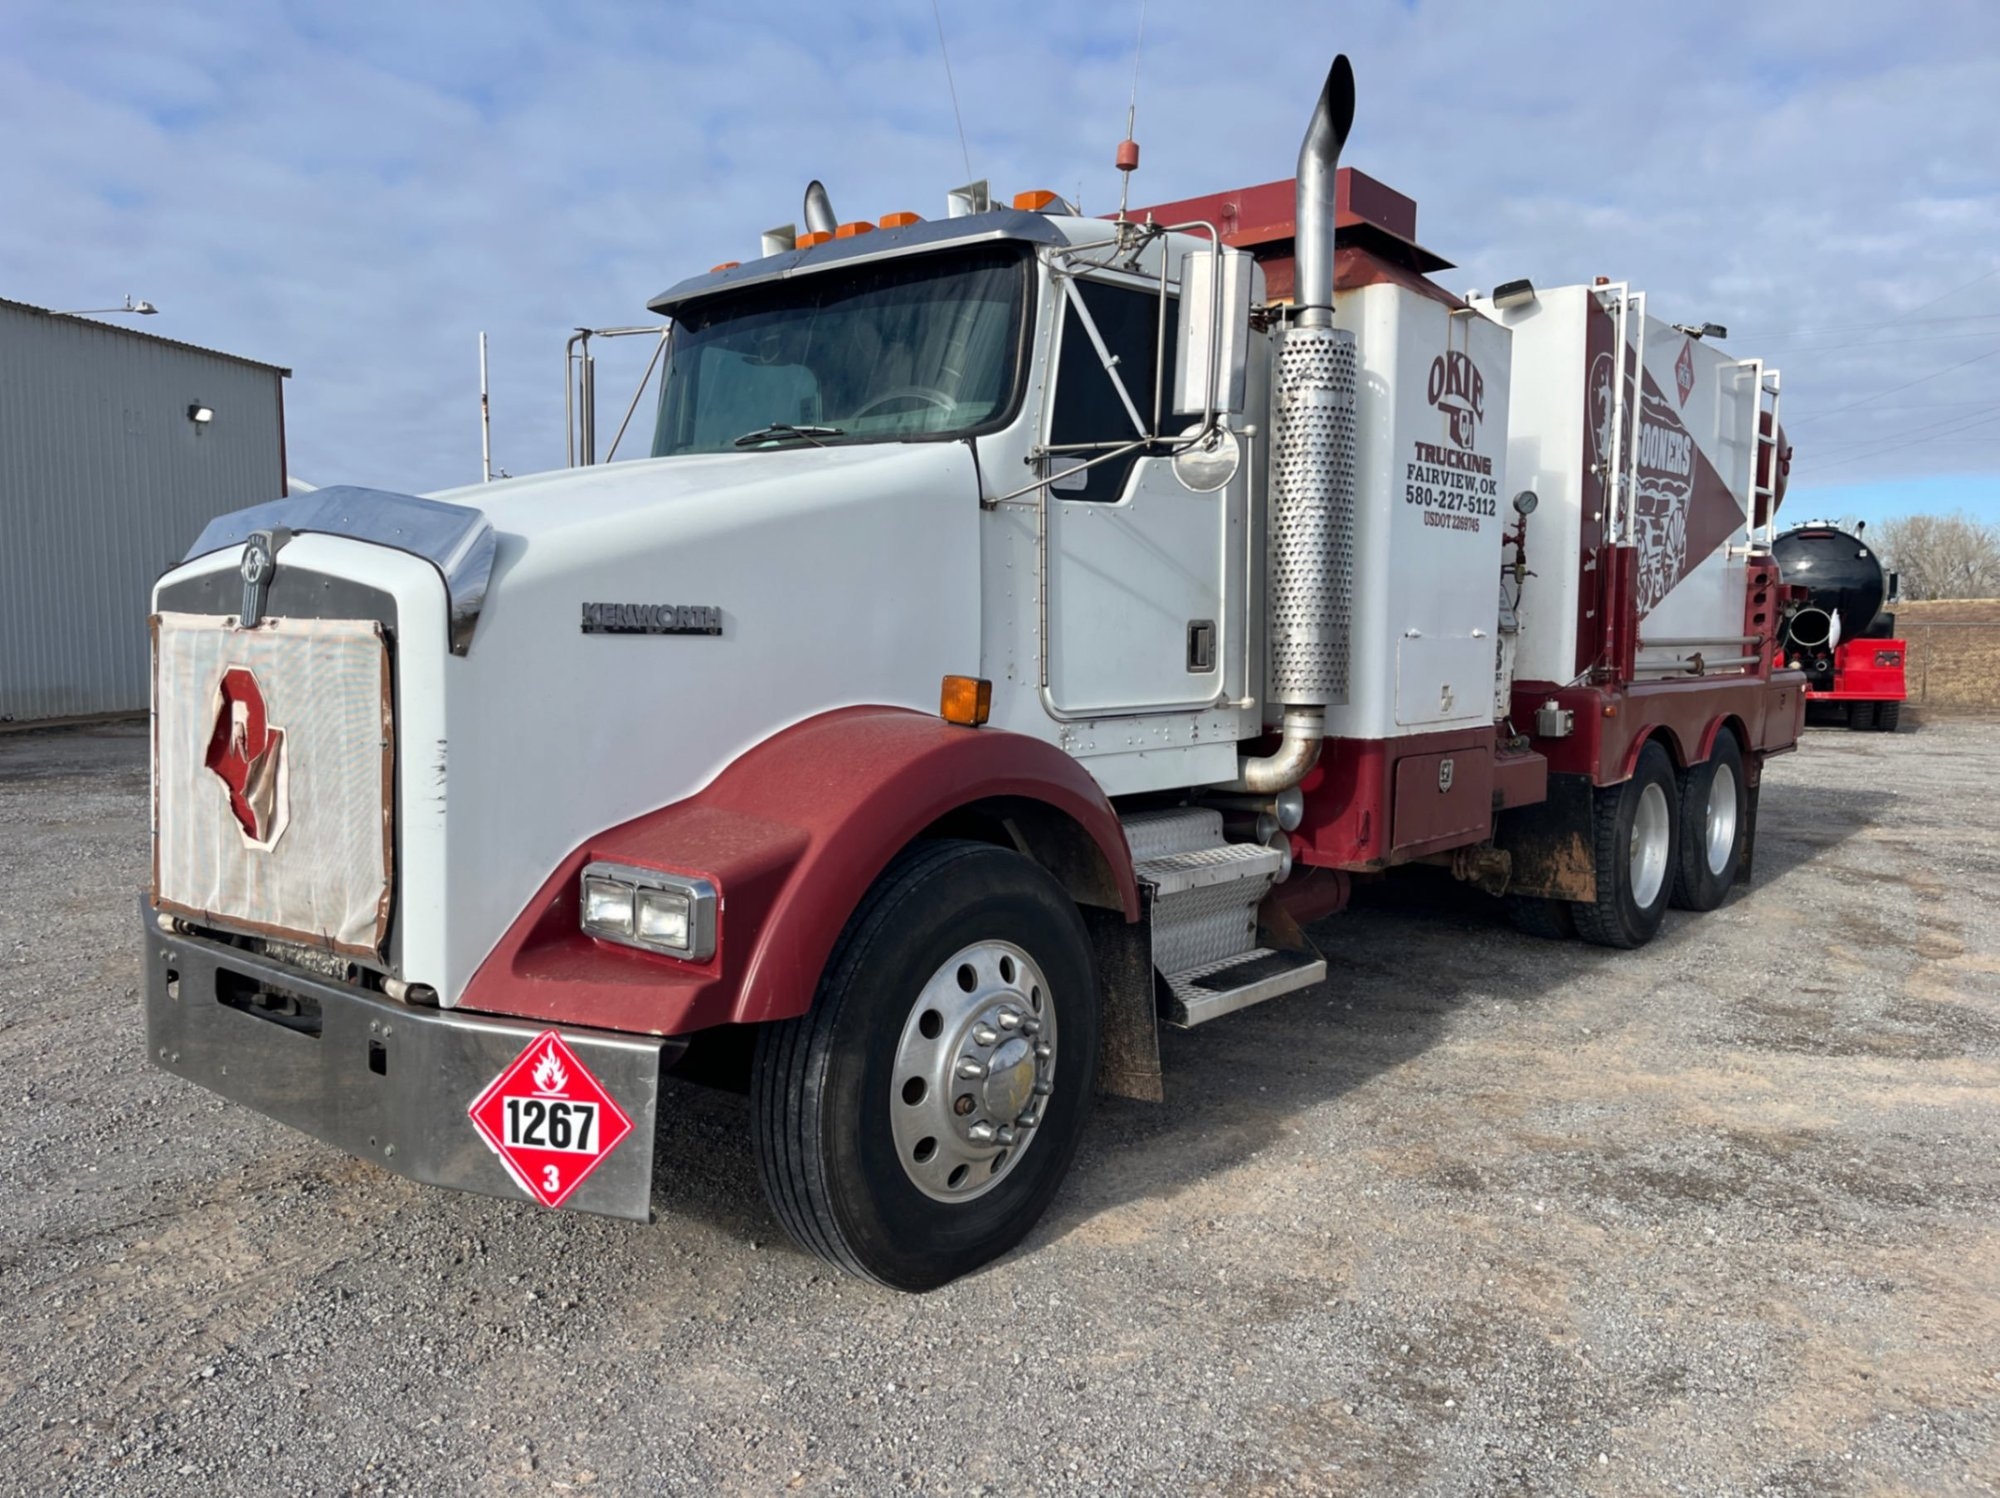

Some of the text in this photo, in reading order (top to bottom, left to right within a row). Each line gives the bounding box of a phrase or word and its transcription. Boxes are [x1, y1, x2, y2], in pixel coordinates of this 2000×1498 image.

[1427, 350, 1484, 424] OKIE
[1415, 441, 1492, 475] TRUCKING
[1407, 463, 1497, 496] FAIRVIEW, OK
[1406, 484, 1496, 516] 580-227-5112
[1424, 510, 1451, 529] USDOT
[581, 602, 723, 630] KENWORTH
[507, 1099, 594, 1150] 1267
[542, 1164, 560, 1192] 3
